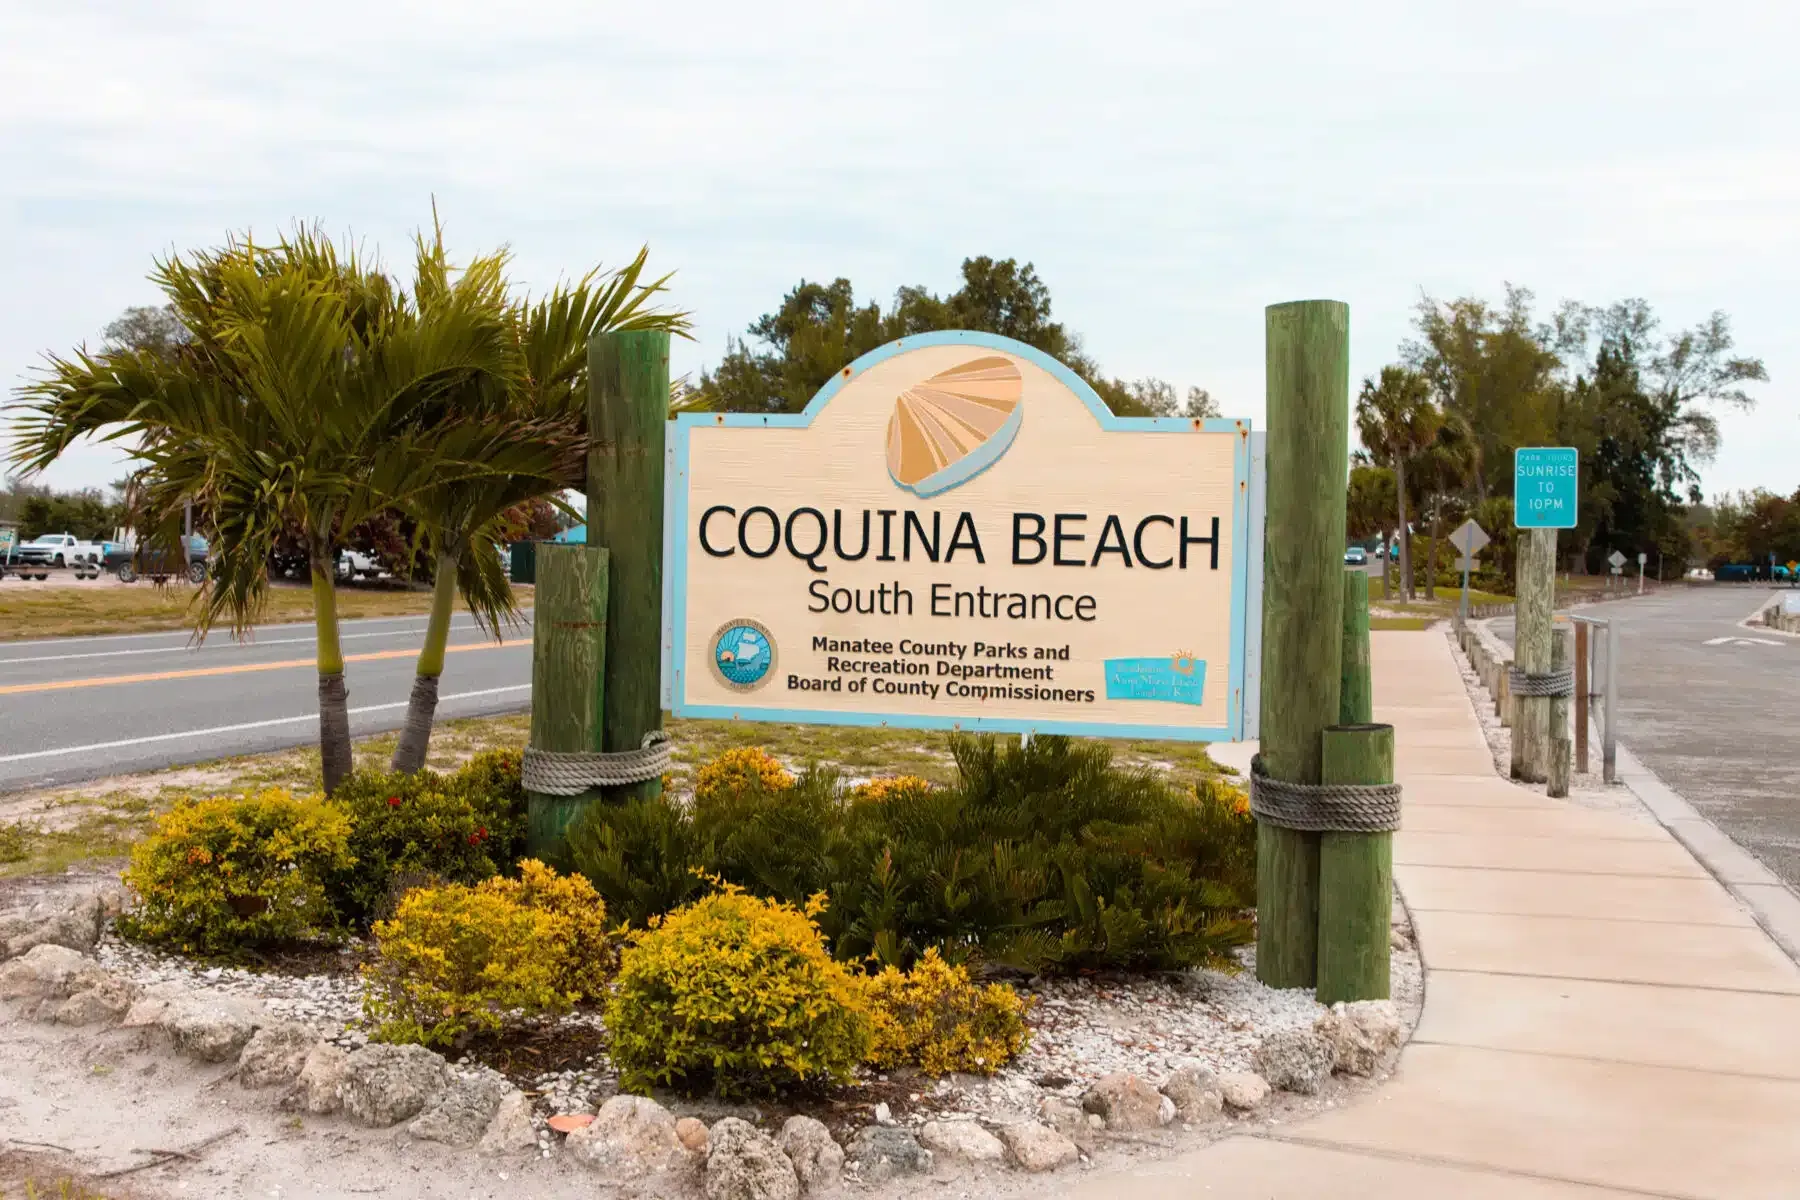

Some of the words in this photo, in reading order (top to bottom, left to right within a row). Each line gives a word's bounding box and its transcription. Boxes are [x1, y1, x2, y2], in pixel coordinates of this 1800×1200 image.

[1518, 465, 1576, 477] SUNRISE
[1538, 481, 1554, 493] TO
[1529, 498, 1563, 510] 10PM
[698, 505, 986, 573] COQUINA
[1011, 512, 1221, 571] BEACH
[808, 579, 913, 616] South
[930, 583, 1097, 622] Entrance
[812, 636, 894, 655] Manatee
[899, 639, 968, 661] County
[973, 641, 1028, 659] Parks
[1033, 644, 1070, 661] and
[827, 656, 930, 676] Recreation
[936, 660, 1054, 681] Department
[787, 674, 842, 692] Board
[847, 676, 868, 693] of
[872, 677, 940, 700] County
[945, 680, 1095, 703] Commissioners
